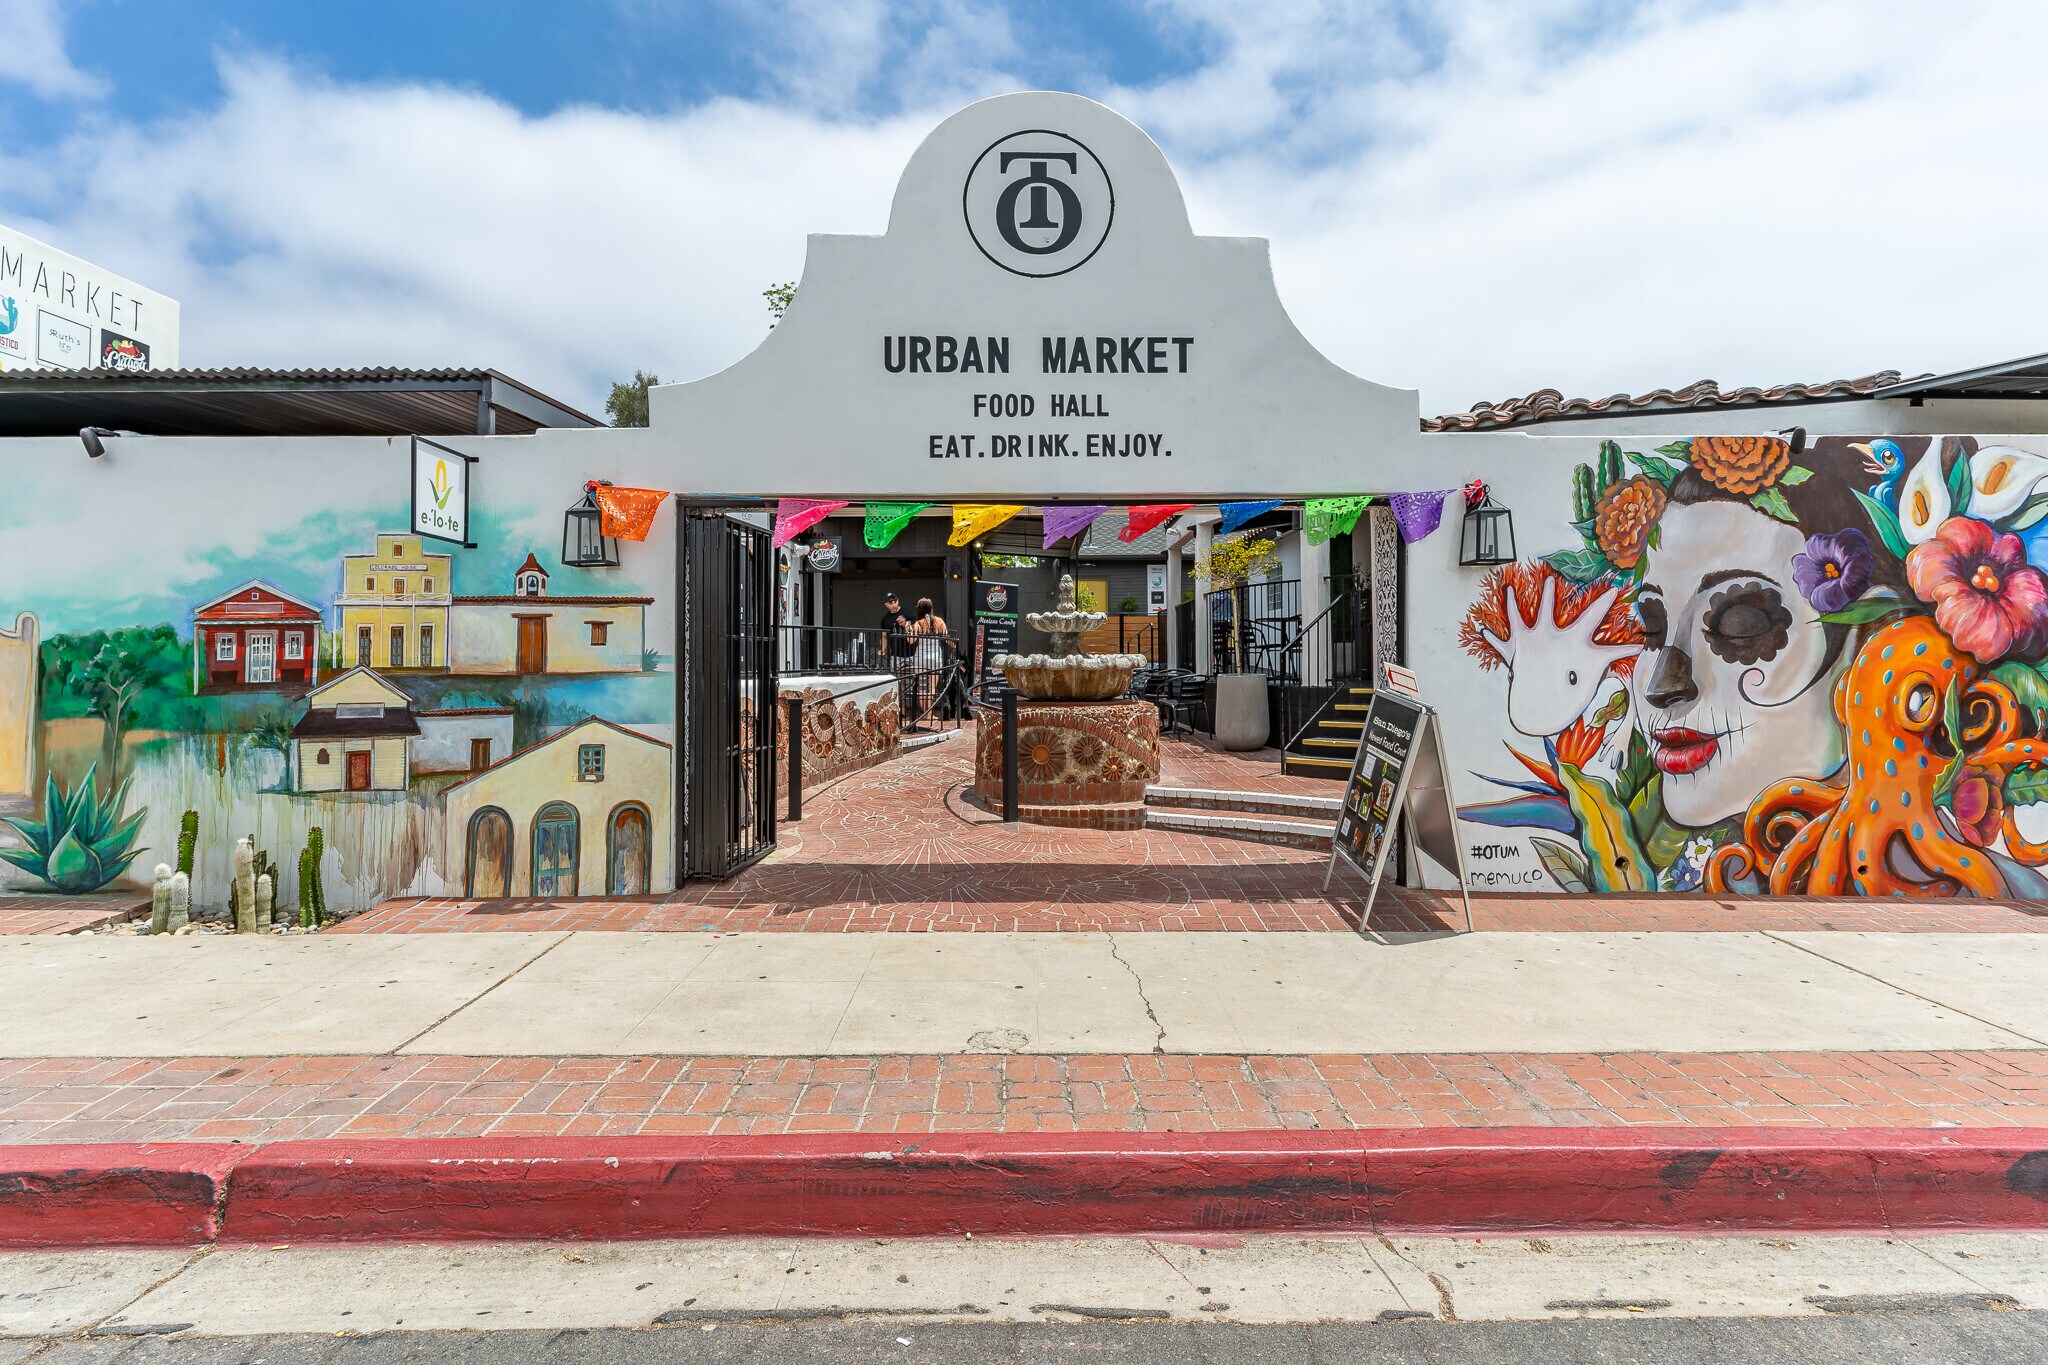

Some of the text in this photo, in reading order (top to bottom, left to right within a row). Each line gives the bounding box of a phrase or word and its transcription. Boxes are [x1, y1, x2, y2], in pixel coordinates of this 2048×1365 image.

[1, 246, 143, 331] MARKET
[883, 335, 1195, 374] URBAN MARKET
[973, 393, 1110, 418] FOOD HALL
[1372, 716, 1412, 740] San Diego's
[1382, 736, 1395, 751] Food
[1393, 743, 1407, 758] Court
[1470, 844, 1520, 860] #OTUM
[1458, 869, 1543, 886] memuco
